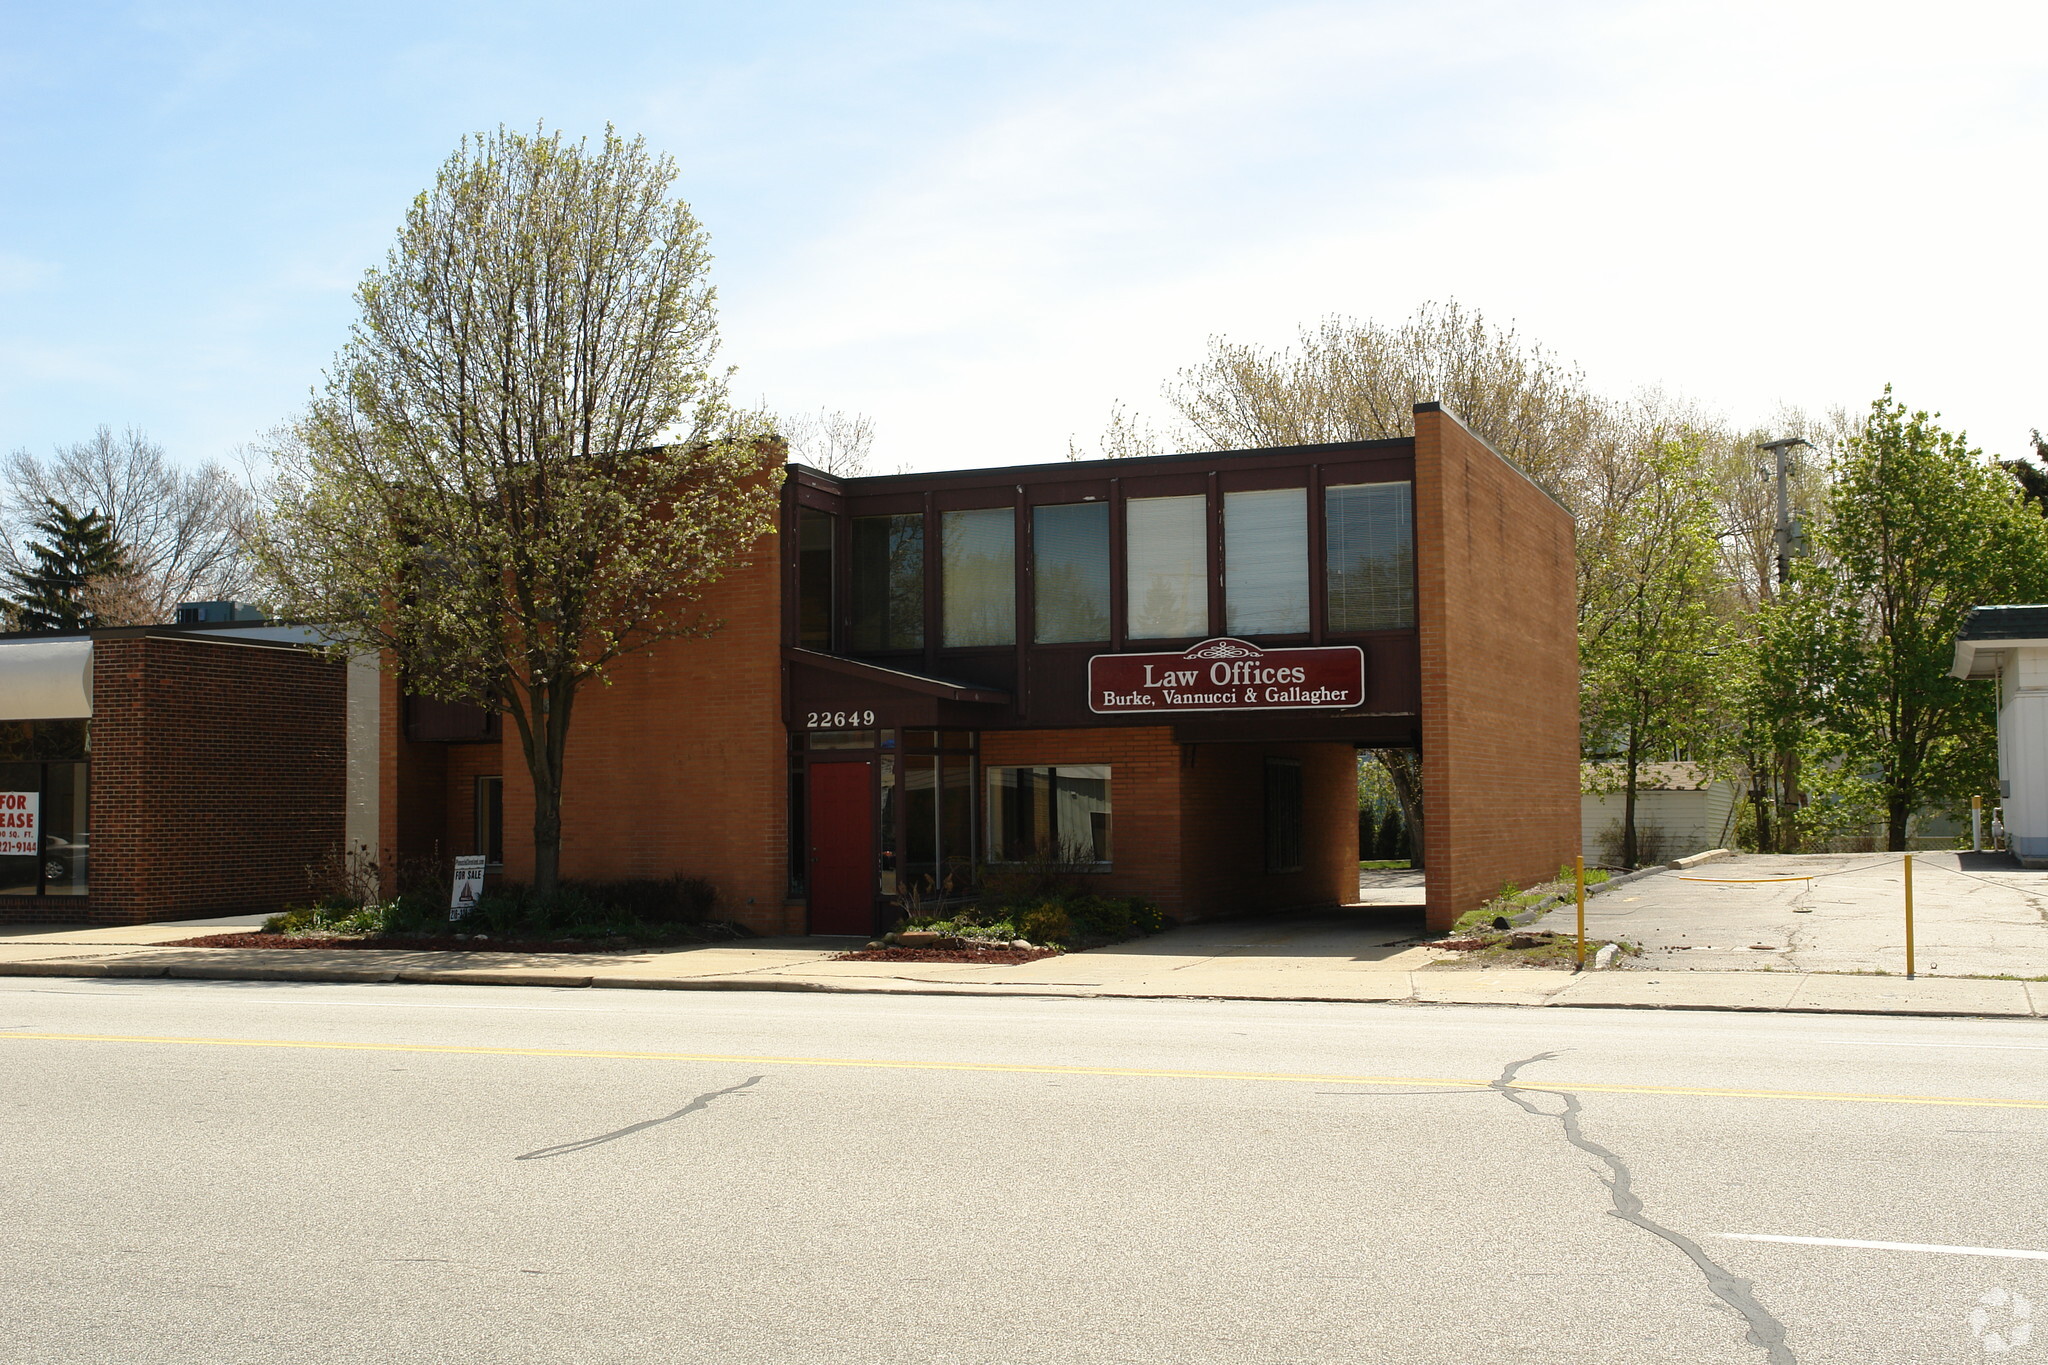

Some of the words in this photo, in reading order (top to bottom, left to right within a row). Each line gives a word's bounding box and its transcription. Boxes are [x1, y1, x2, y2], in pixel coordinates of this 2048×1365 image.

[1143, 664, 1199, 688] Law
[1210, 661, 1306, 686] Offices
[1103, 690, 1156, 707] Burke,
[1162, 688, 1237, 705] Vannucci
[1244, 687, 1258, 703] &
[1265, 686, 1349, 705] Gallagher
[806, 710, 875, 728] 22649
[0, 794, 27, 810] FOR
[0, 812, 34, 829] EASE
[9, 830, 20, 839] SQ.
[24, 831, 34, 839] FT.
[0, 841, 37, 853] 21-9144
[455, 870, 466, 880] FOR
[467, 870, 482, 880] SALE
